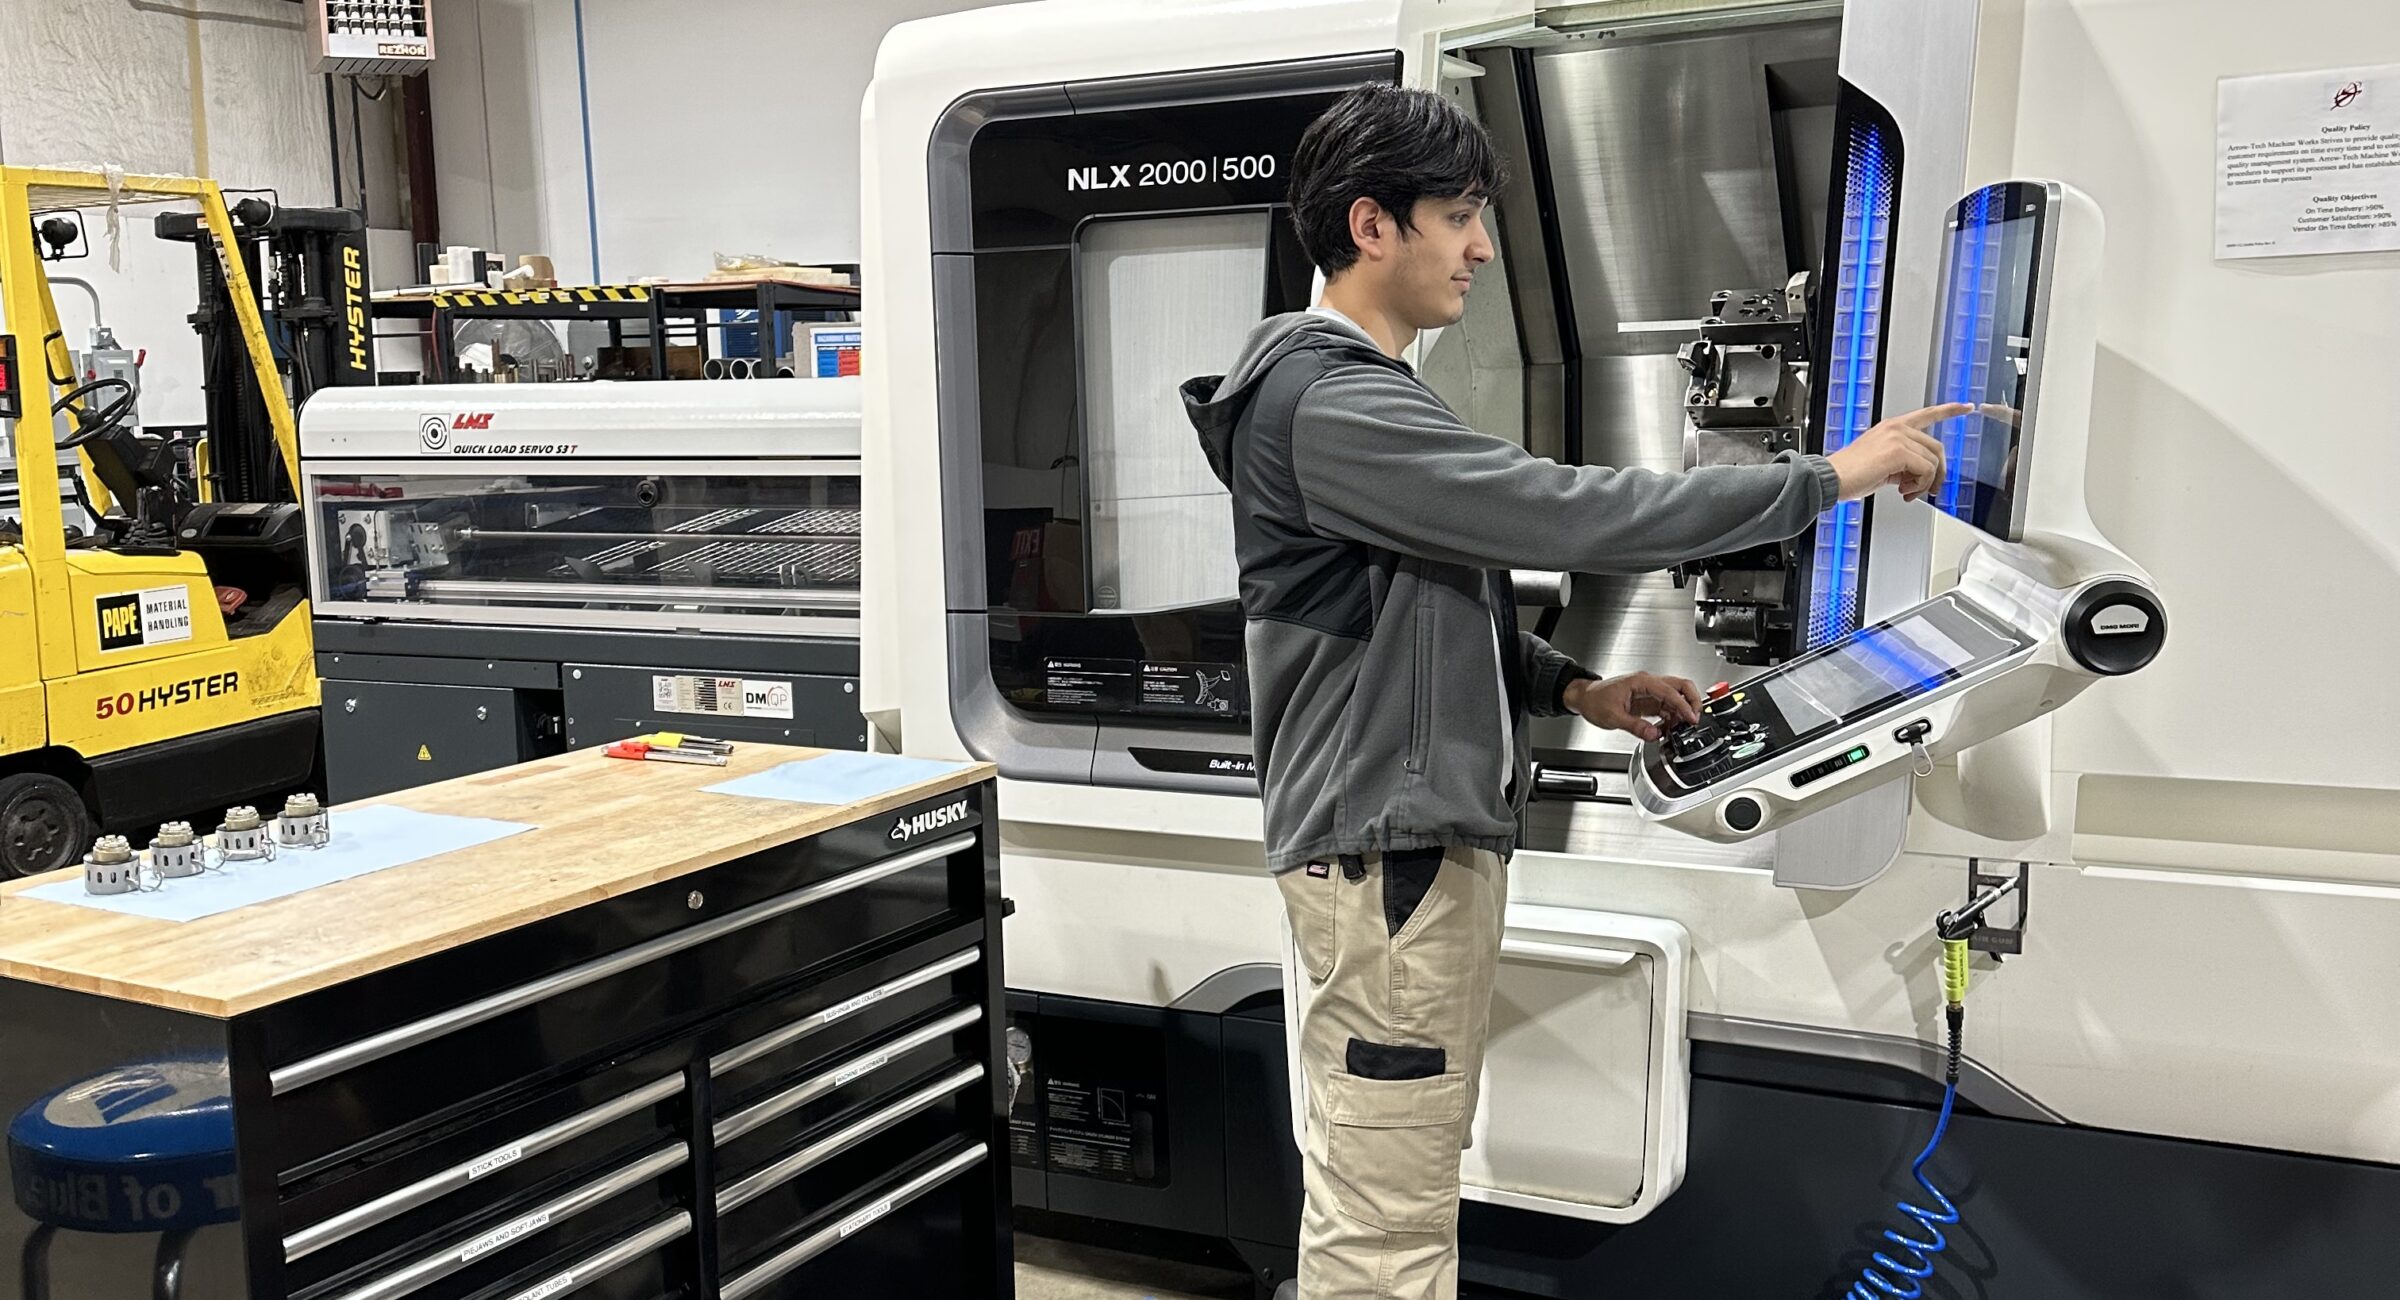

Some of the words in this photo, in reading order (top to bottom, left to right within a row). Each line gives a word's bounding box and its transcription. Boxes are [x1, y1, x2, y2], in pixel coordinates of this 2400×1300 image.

[380, 45, 425, 55] REZNOR
[2228, 143, 2266, 151] Arrow-Tech
[2353, 135, 2378, 143] provide
[2258, 150, 2299, 158] requirements
[2227, 162, 2249, 170] quality
[2250, 159, 2291, 167] management
[1068, 165, 1131, 191] NLX
[2227, 170, 2261, 179] procedures
[2313, 195, 2339, 203] Quality
[2340, 194, 2377, 202] Objectives
[343, 246, 367, 370] HYSTER
[454, 445, 486, 454] QUICK
[488, 445, 516, 454] LOAD
[520, 445, 553, 454] SERVO
[146, 599, 187, 614] MATERIAL
[148, 616, 189, 632] HANDLING
[96, 692, 135, 720] 50
[139, 671, 238, 712] HYSTER
[912, 800, 967, 835] HUSKY
[472, 1161, 493, 1174] STICK
[494, 1150, 517, 1164] TOOLS
[463, 1239, 493, 1257] PIEJAWS
[495, 1231, 510, 1242] AND
[545, 1275, 568, 1292] TUBES
